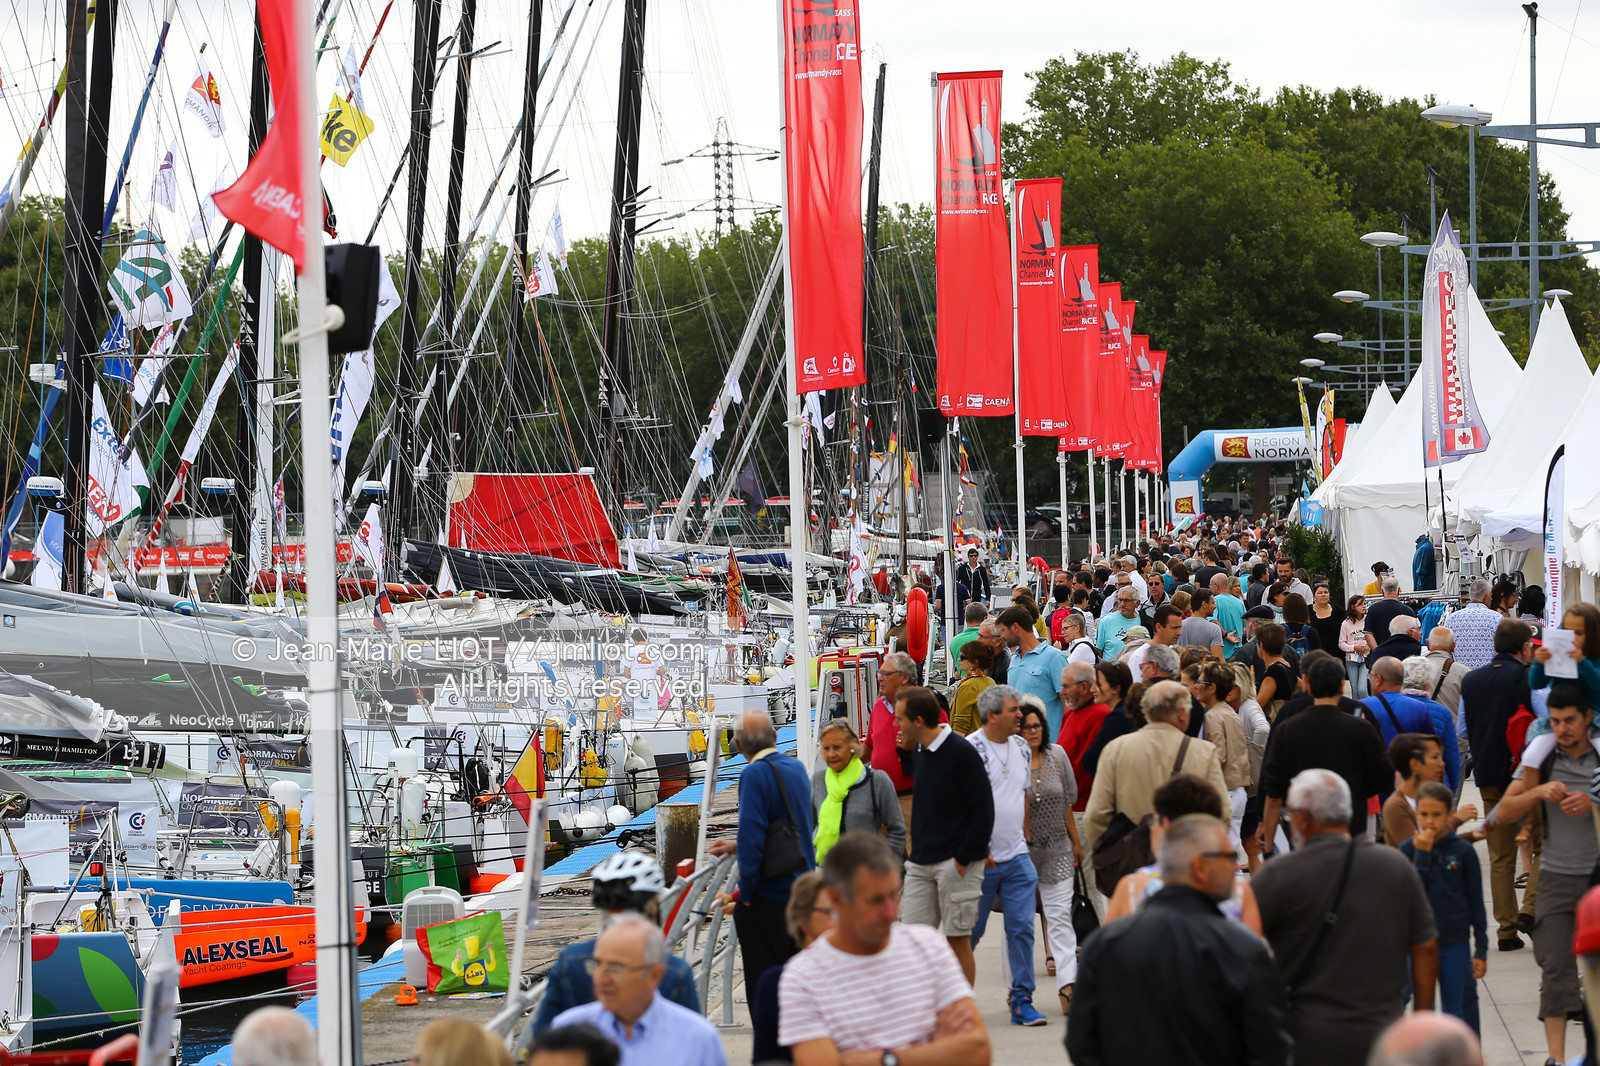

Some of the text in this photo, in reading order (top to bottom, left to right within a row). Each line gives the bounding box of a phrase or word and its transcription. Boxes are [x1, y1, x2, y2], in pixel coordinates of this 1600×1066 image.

[1443, 272, 1463, 423] WINNIPEG
[1254, 435, 1300, 447] RÉGION
[1254, 446, 1310, 459] NORMA
[169, 713, 234, 729] NeoCycle
[26, 744, 54, 752] MELVIN
[61, 746, 98, 754] HAMILTON
[183, 935, 288, 966] ALEXSEAL
[184, 961, 247, 976] Yacht Coatings
